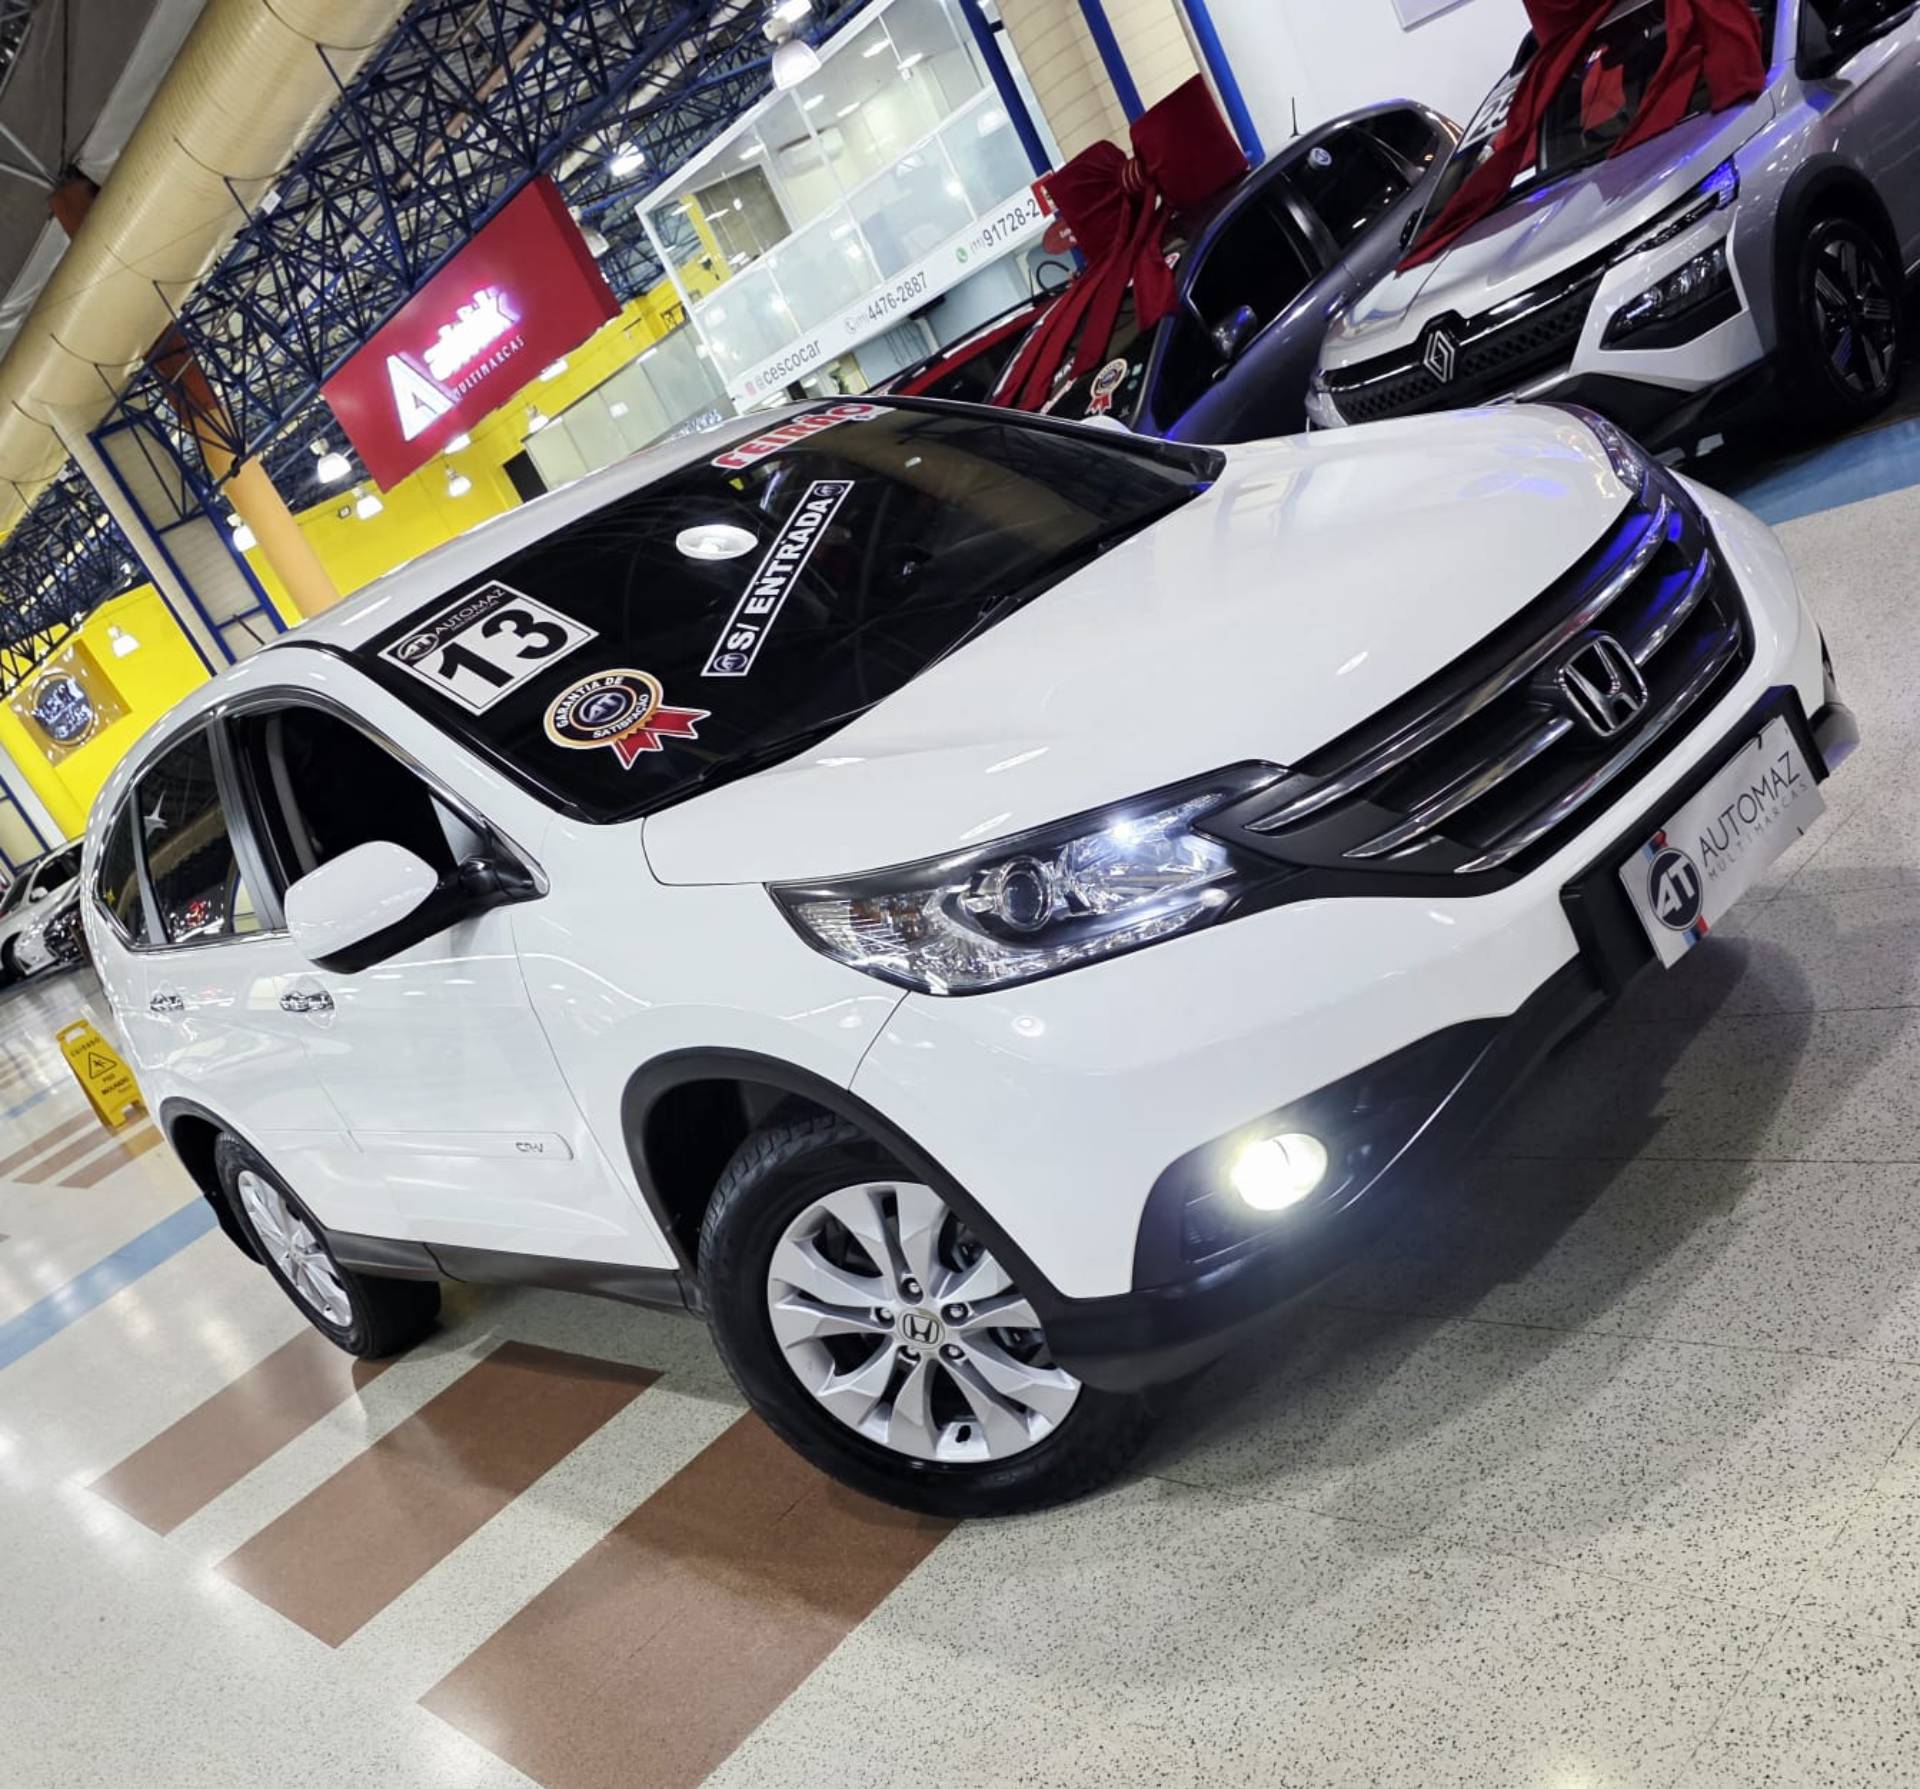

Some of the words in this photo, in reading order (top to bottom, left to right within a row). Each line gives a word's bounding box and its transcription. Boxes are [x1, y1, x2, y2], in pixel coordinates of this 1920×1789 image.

[868, 271, 928, 321] 4476-2887
[744, 498, 834, 614] ENTRADA
[435, 588, 506, 636] AUTOMAZ
[437, 609, 568, 688] 13
[556, 681, 601, 729] GARANTIA
[604, 676, 624, 686] DE
[592, 694, 649, 739] SATISFAÇÃO
[1699, 751, 1800, 868] AUTOMAZ
[1707, 782, 1809, 882] MULTIMARCAS
